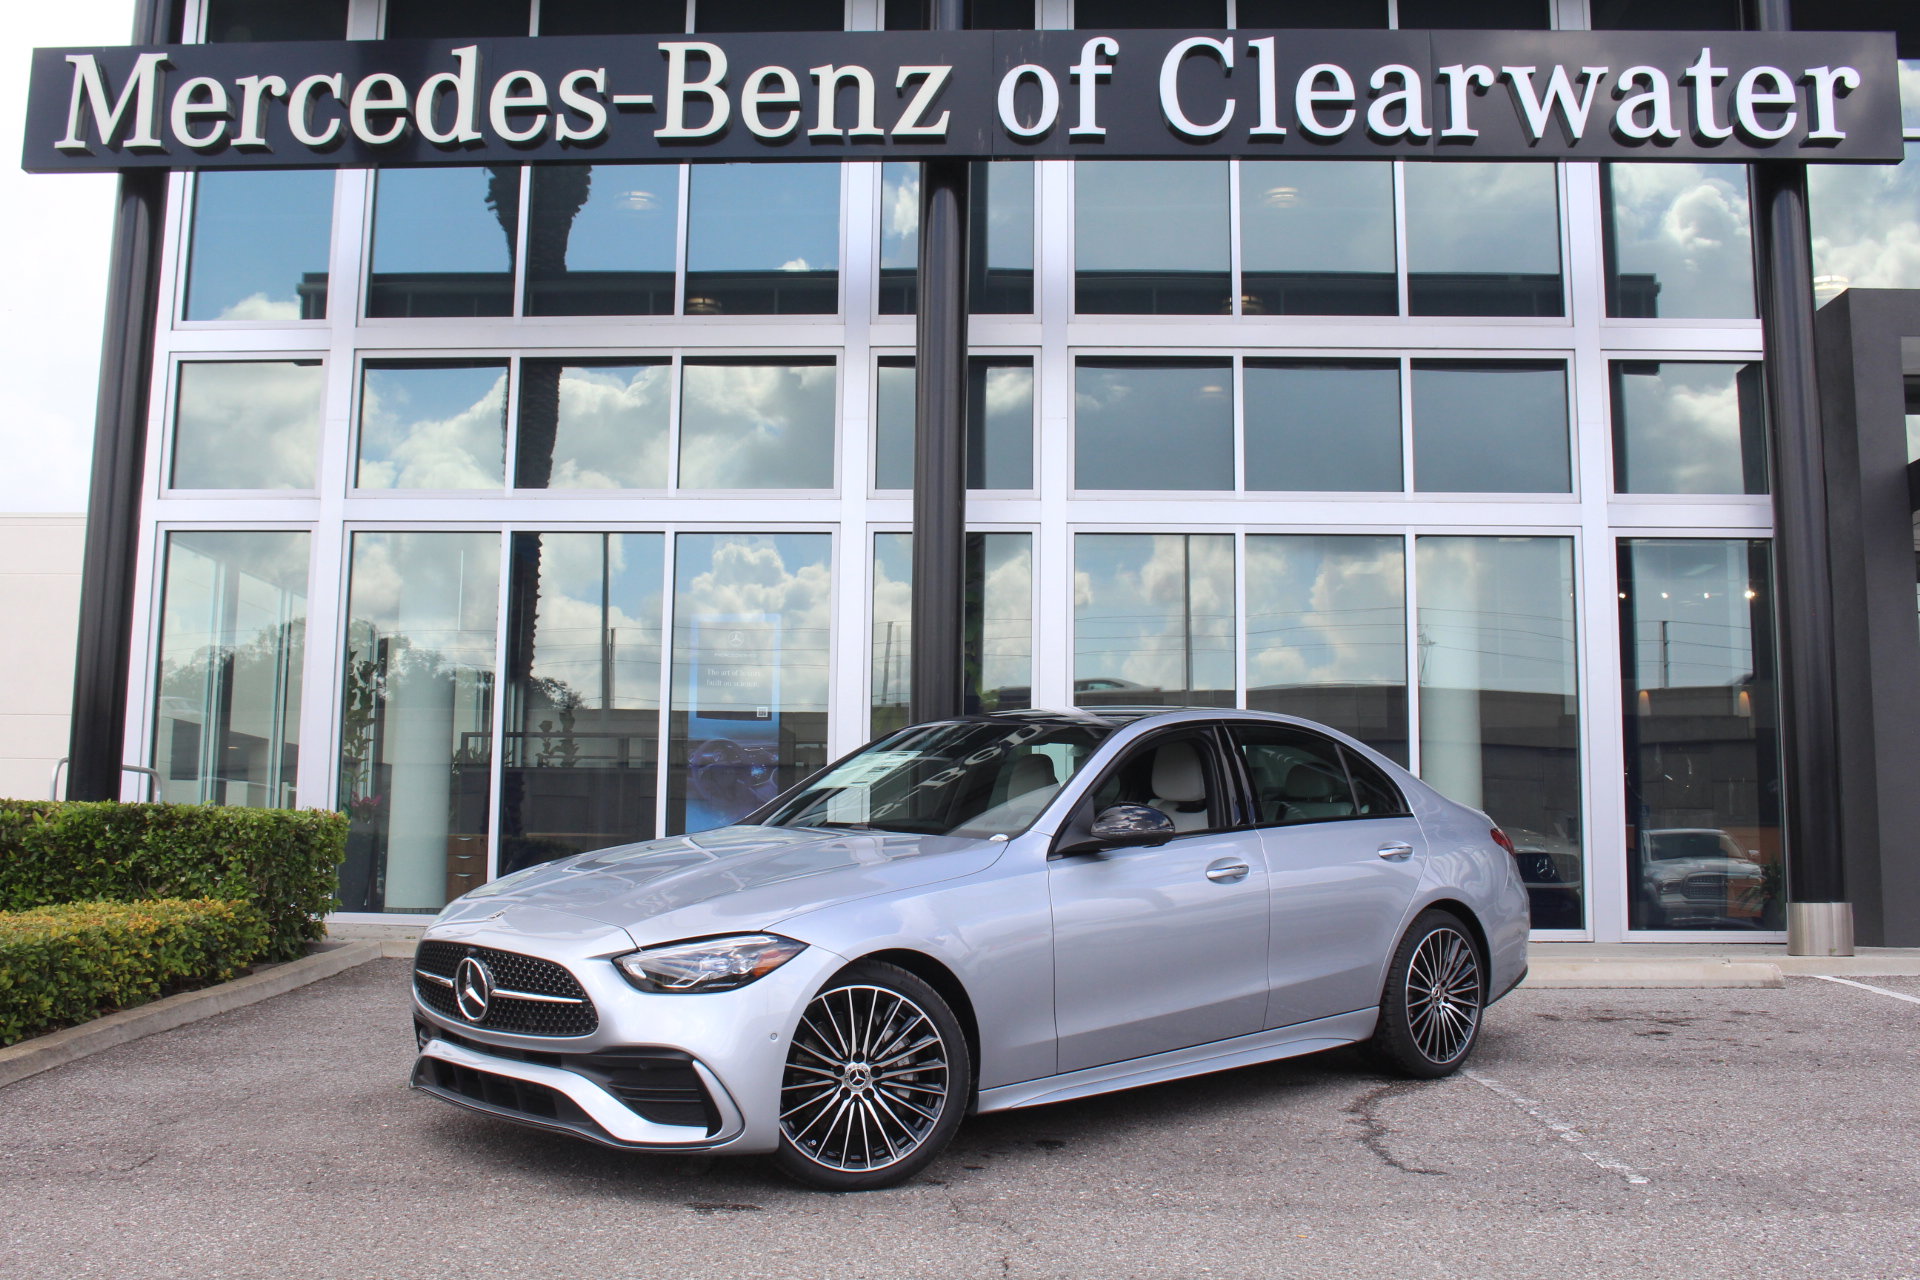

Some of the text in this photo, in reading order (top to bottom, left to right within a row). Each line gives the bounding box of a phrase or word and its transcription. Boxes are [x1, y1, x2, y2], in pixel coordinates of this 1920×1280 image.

[55, 36, 1861, 149] Mercedes-Benz of Clearwater
